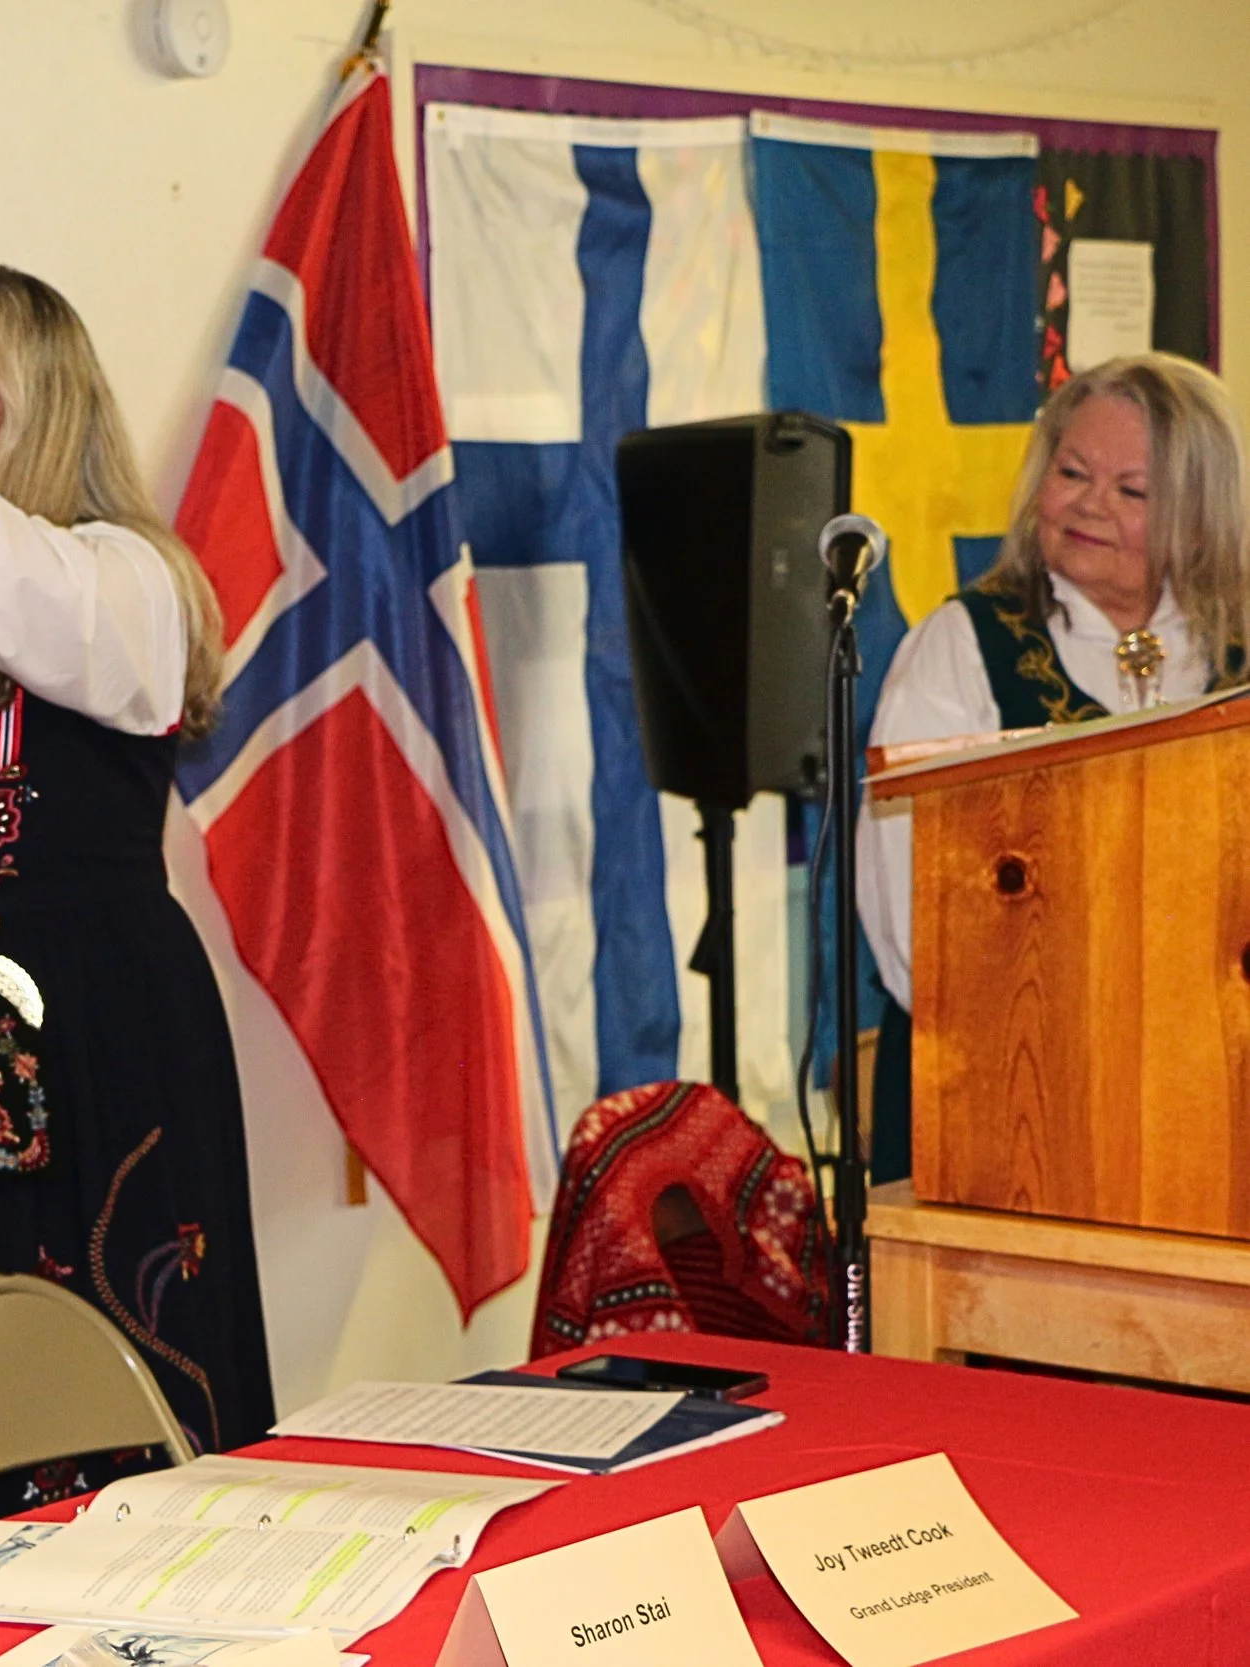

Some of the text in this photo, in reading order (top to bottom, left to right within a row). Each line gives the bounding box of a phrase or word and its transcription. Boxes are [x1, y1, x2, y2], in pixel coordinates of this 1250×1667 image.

[814, 1521, 954, 1573] Joy Tweedt Cook
[570, 1595, 672, 1648] Sharon Stai
[849, 1571, 995, 1620] Grand Lodge President
